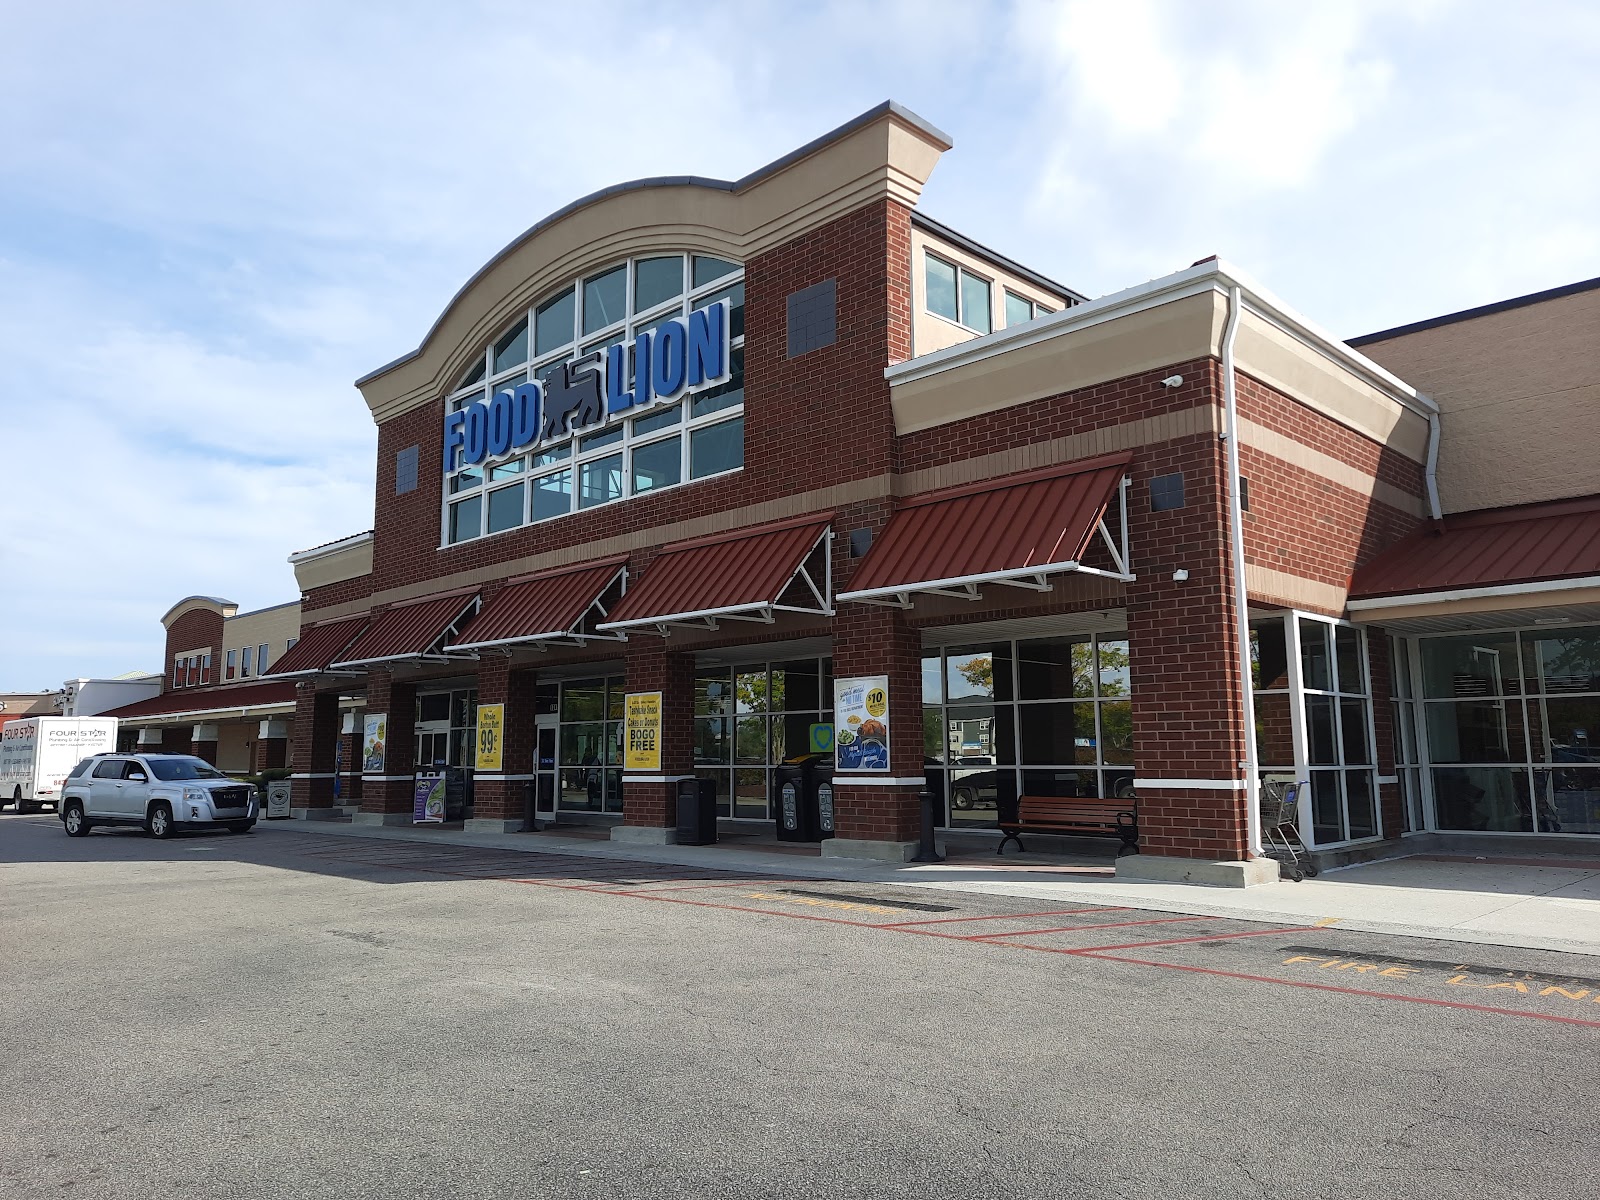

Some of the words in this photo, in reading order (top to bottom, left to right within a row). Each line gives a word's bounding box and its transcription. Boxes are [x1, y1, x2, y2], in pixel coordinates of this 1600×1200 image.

[444, 382, 540, 473] FOOD
[608, 302, 723, 414] LION
[867, 692, 882, 704] $10
[628, 718, 639, 727] Cakes
[4, 728, 18, 740] FOUR
[80, 729, 106, 737] STAR
[630, 729, 655, 739] BOGO
[630, 740, 655, 751] FREE
[1282, 955, 1421, 980] FIRE
